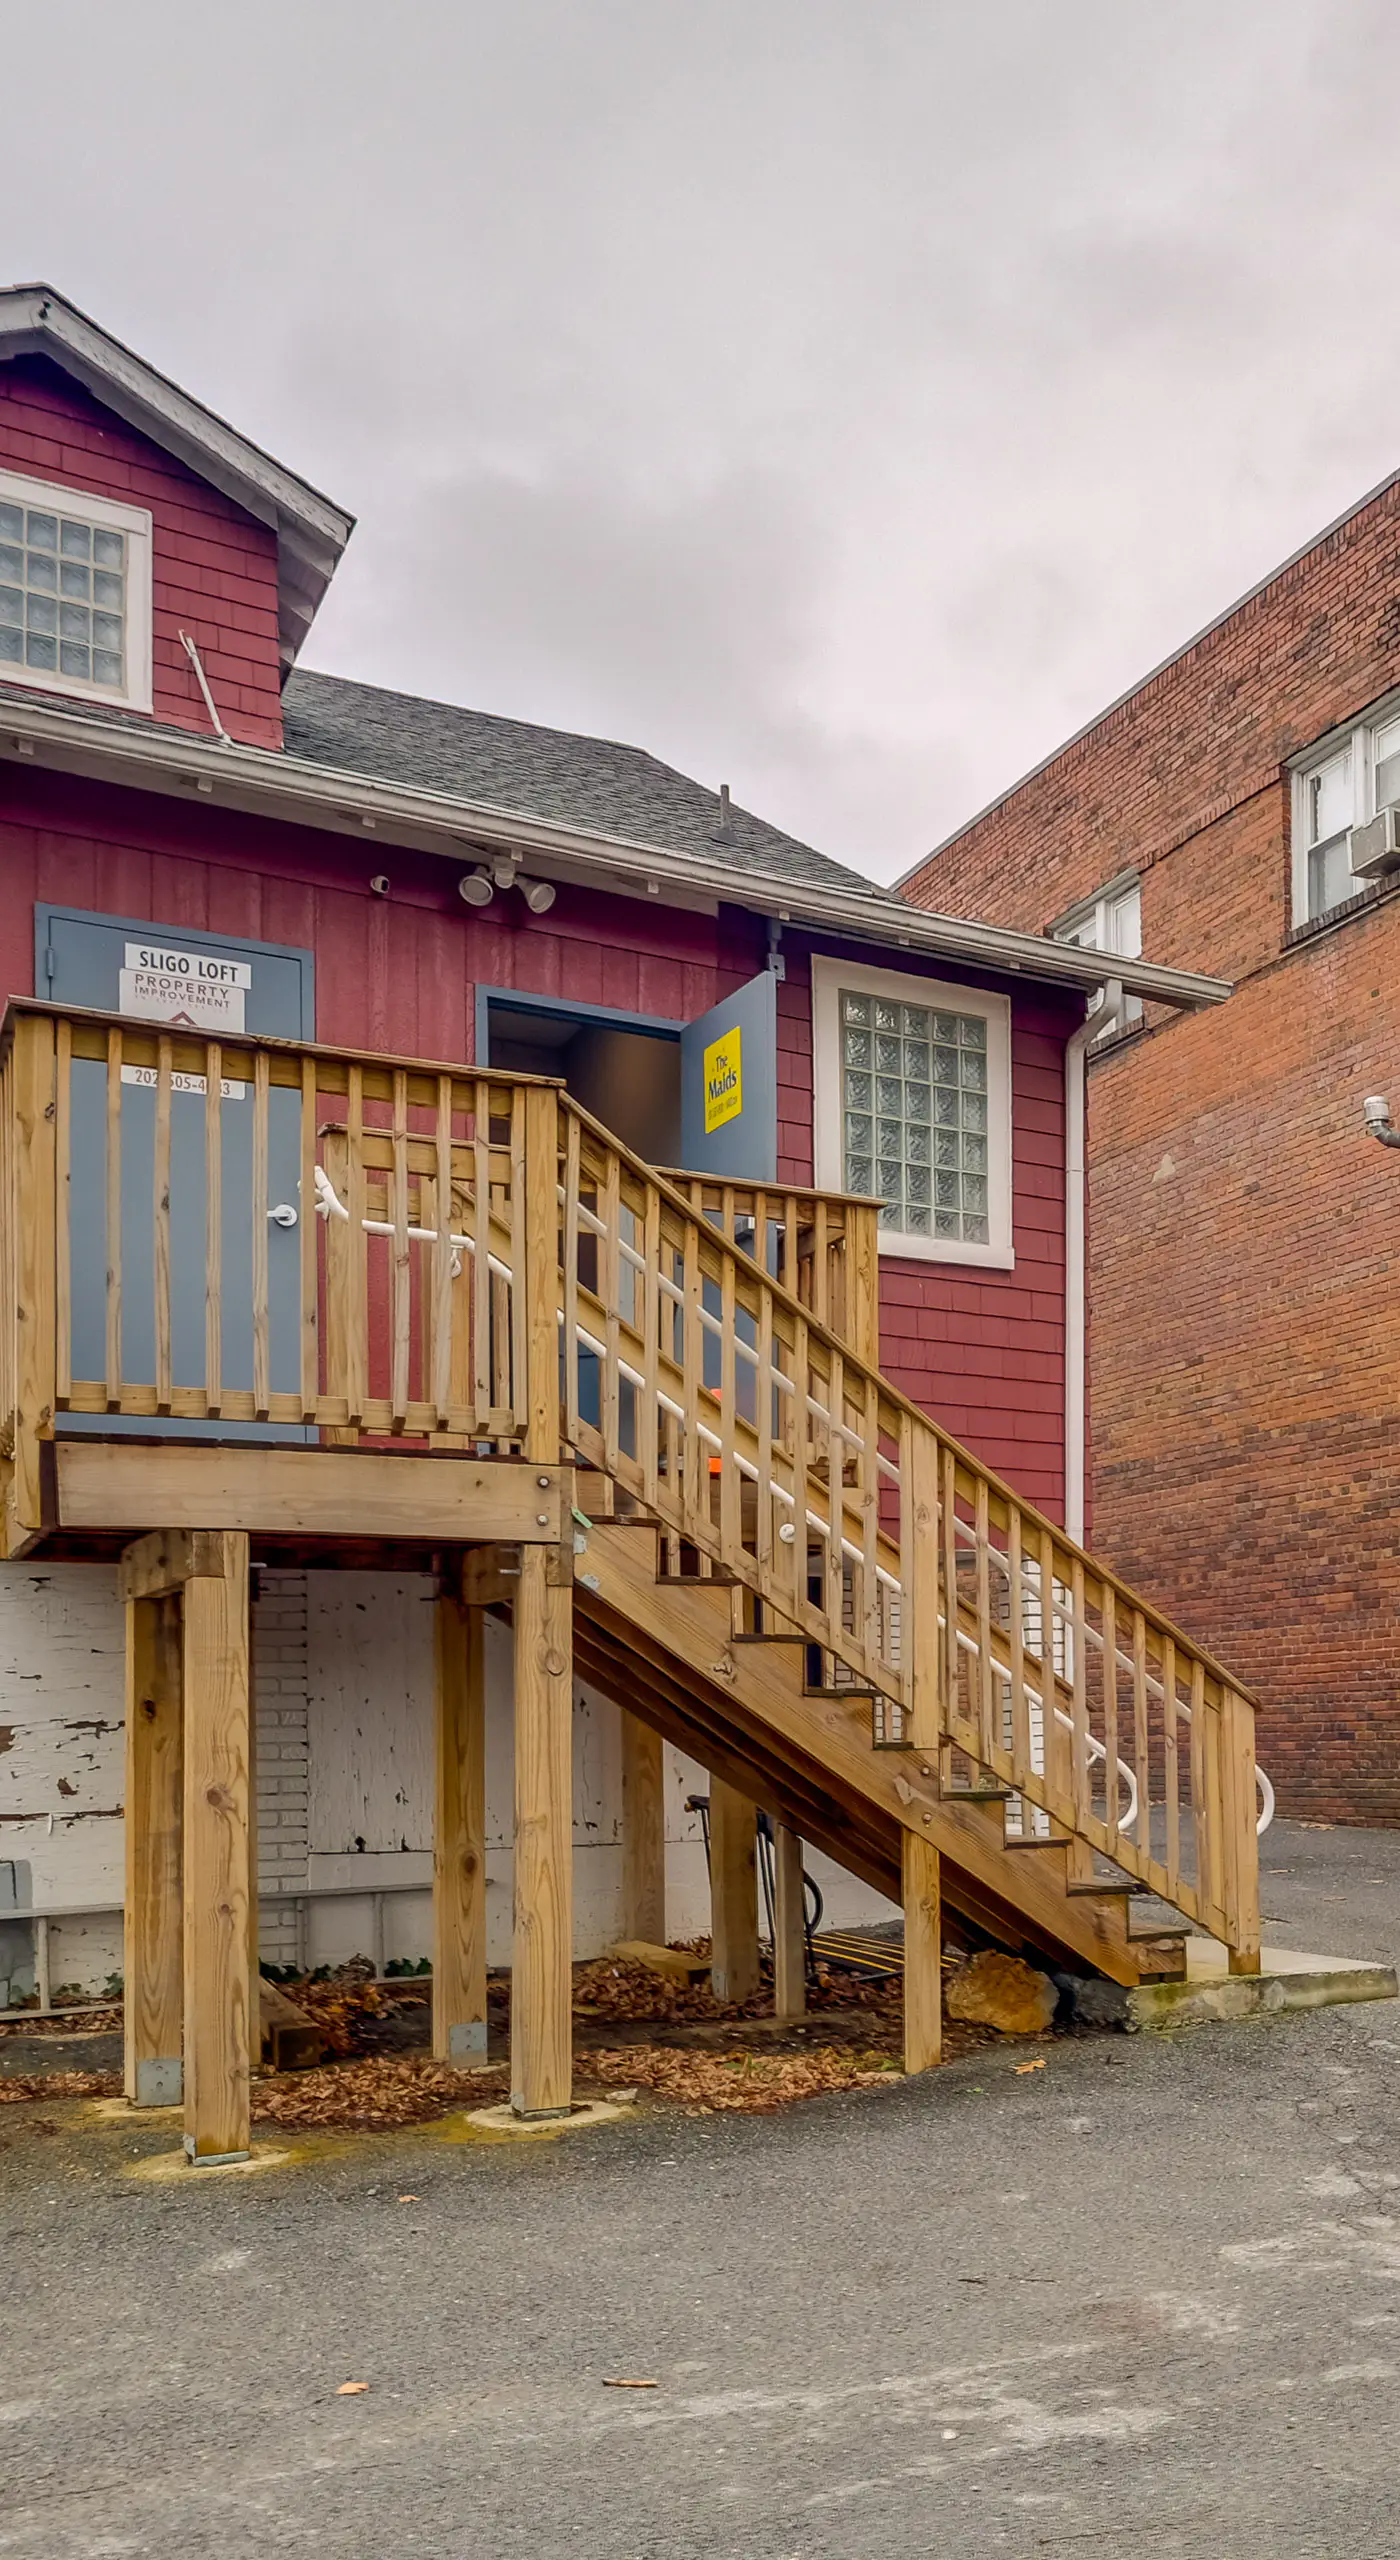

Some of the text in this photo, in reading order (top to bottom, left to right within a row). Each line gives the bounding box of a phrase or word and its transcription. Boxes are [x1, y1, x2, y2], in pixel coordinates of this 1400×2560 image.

[139, 951, 239, 982] SLIGO LOFT
[134, 986, 230, 1009] IMPROVEMENT
[135, 973, 229, 999] PROPERTY
[715, 1055, 728, 1072] The
[708, 1067, 737, 1103] Maids
